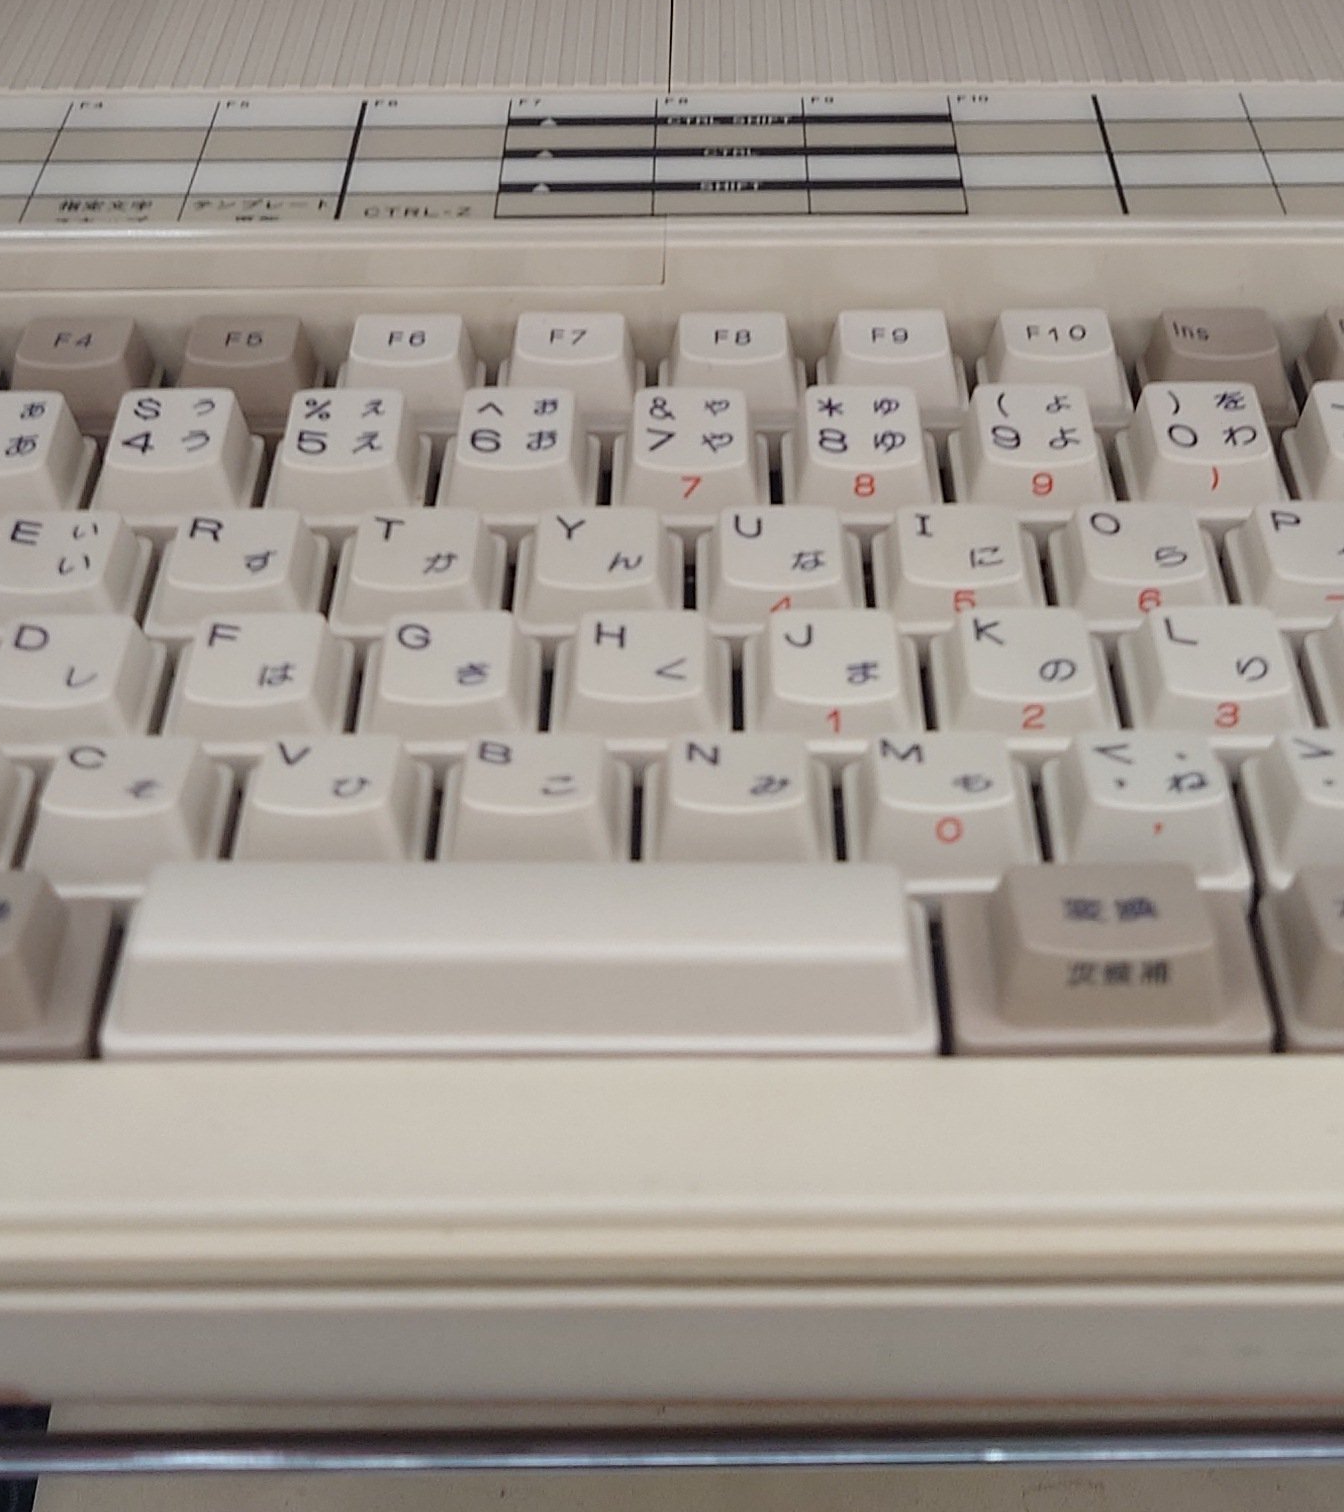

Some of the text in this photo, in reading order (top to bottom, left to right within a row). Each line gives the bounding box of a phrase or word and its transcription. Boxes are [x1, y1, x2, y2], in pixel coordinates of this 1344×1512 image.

[54, 333, 92, 348] F4
[225, 332, 262, 347] F5
[388, 332, 425, 346] F6
[550, 329, 586, 345] F7
[715, 330, 751, 345] F8
[872, 328, 908, 342] F9
[1026, 325, 1086, 342] F10
[1171, 322, 1210, 341] Ins
[134, 398, 161, 420] $
[305, 399, 331, 420] %
[649, 397, 675, 420] &
[122, 432, 153, 454] 4
[297, 430, 327, 454] 5
[470, 429, 501, 452] 6
[647, 428, 733, 453] 7 や
[818, 428, 906, 453] 8 ゆ
[991, 426, 1079, 449] 9 よ
[1224, 426, 1257, 446] わ
[683, 476, 701, 497] 7
[854, 474, 875, 497] 8
[1033, 474, 1053, 494] 9
[189, 518, 223, 542] R
[376, 517, 404, 541] T
[557, 516, 585, 540] Y
[734, 514, 762, 538] U
[916, 514, 931, 537] I
[1271, 511, 1301, 531] P
[10, 521, 41, 545] E
[58, 555, 90, 575] い
[608, 553, 642, 572] ん
[792, 551, 824, 570] な
[970, 546, 1003, 568] に
[13, 624, 49, 651] D
[208, 623, 239, 647] F
[397, 624, 431, 650] G
[595, 622, 626, 648] H
[785, 624, 813, 648] J
[973, 618, 1003, 644] K
[1164, 617, 1197, 645] L
[65, 667, 96, 688] し
[258, 663, 293, 687] は
[457, 663, 487, 685] き
[655, 658, 685, 680] く
[847, 662, 878, 684] ま
[1039, 659, 1077, 682] の
[828, 708, 841, 732] 1
[1022, 704, 1044, 729] 2
[1219, 703, 1239, 727] 3
[68, 746, 106, 769] C
[278, 742, 310, 766] V
[478, 741, 512, 765] B
[687, 742, 720, 766] N
[880, 739, 924, 763] M
